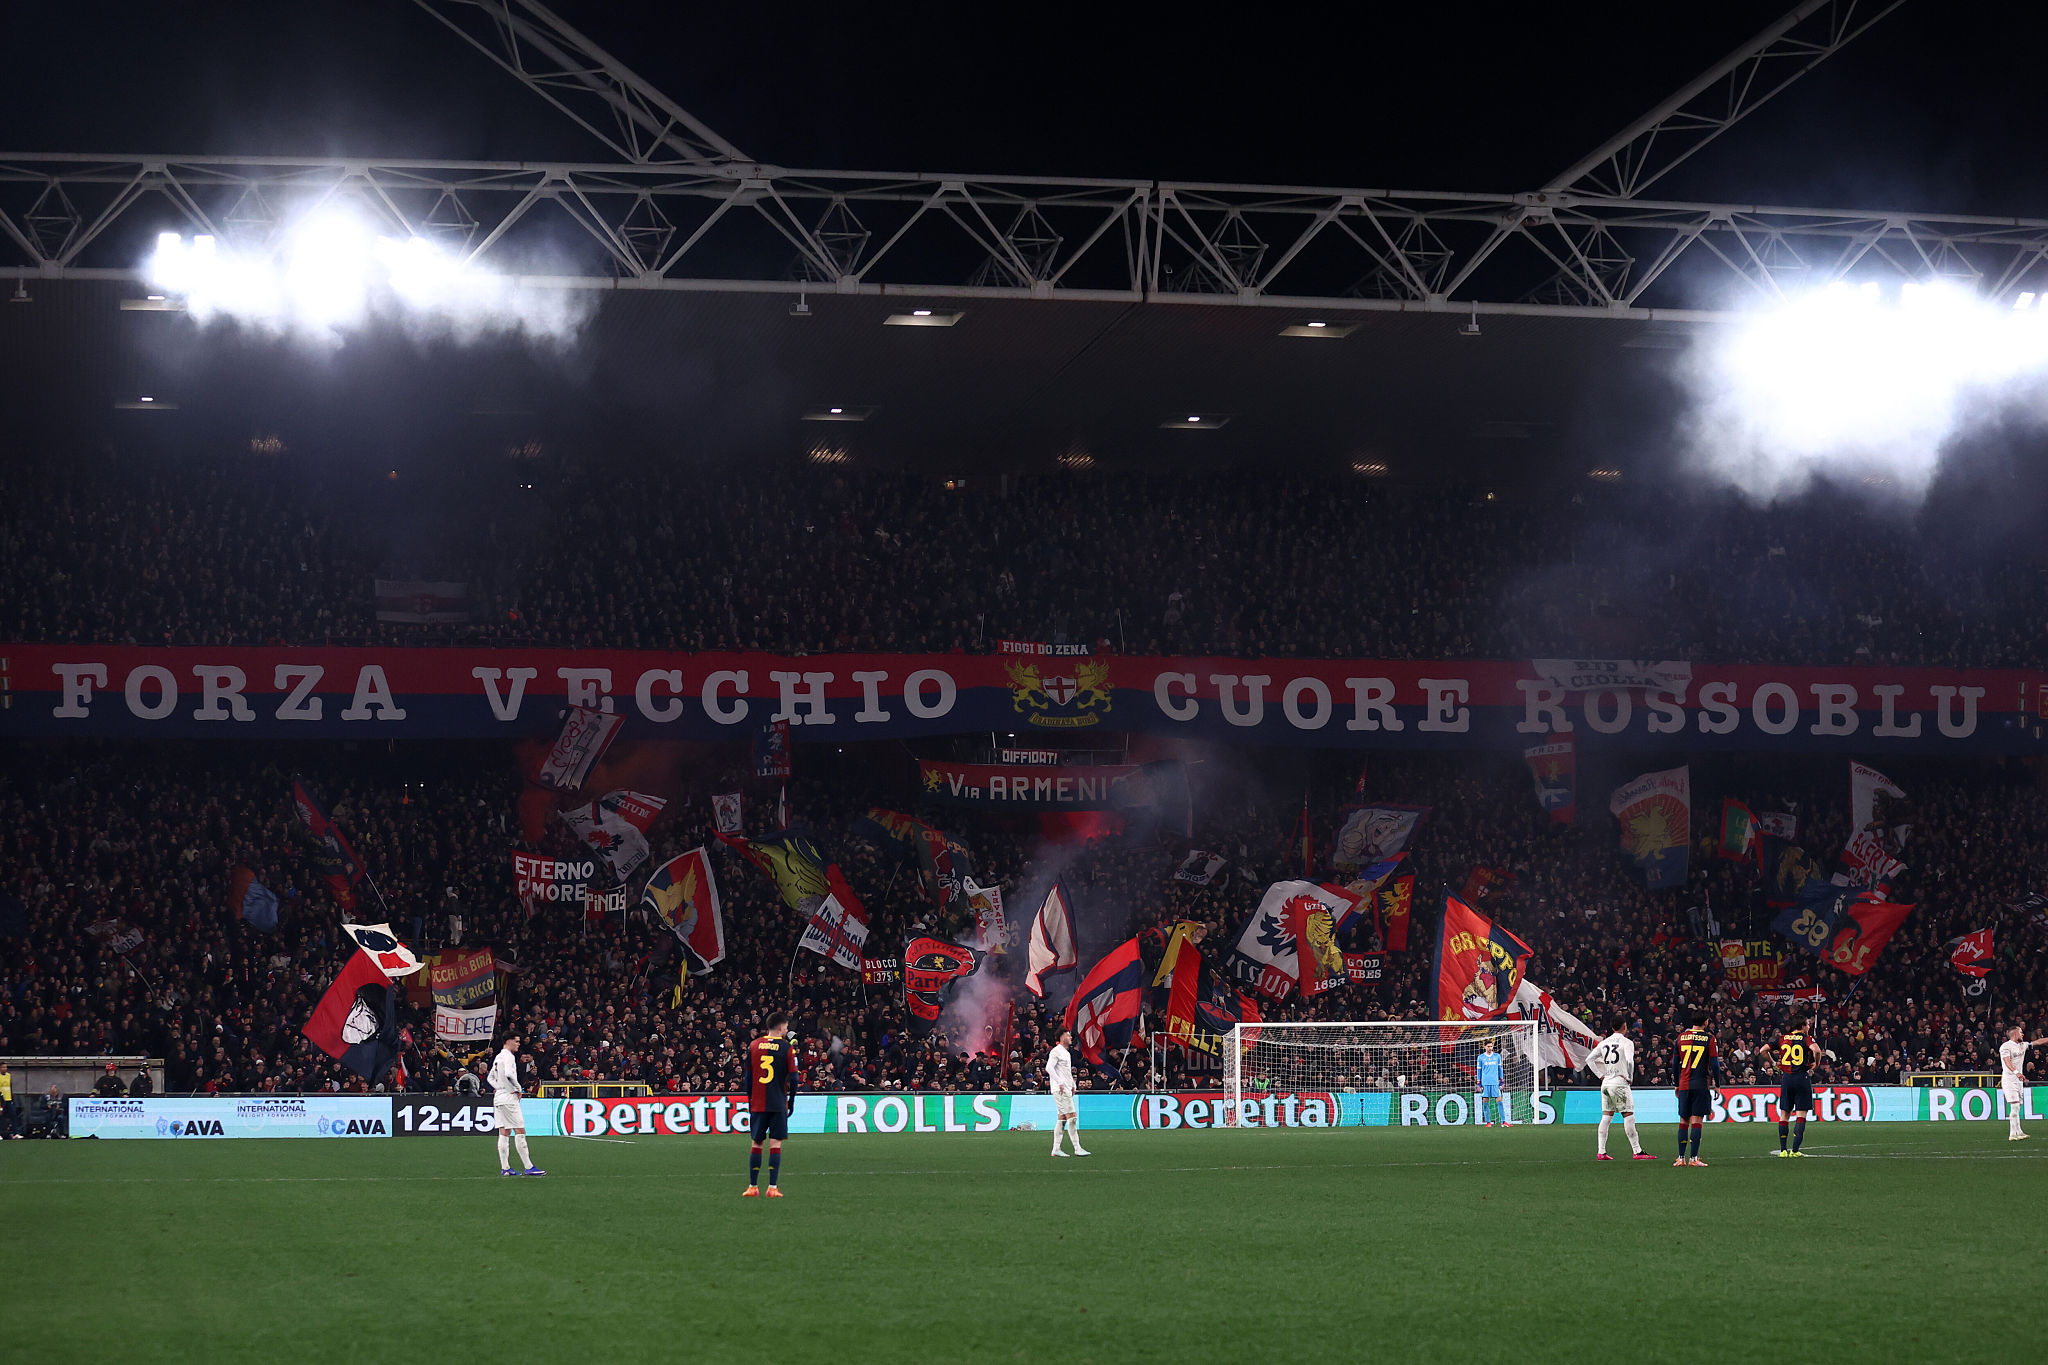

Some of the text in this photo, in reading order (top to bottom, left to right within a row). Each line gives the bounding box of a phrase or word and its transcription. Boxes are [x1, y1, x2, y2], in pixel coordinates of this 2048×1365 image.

[1003, 641, 1089, 656] FIGGI DO ZENA
[53, 663, 1985, 738] FORZA VECCHIO CUORE ROSSOBLU
[1003, 748, 1058, 765] DIFFIDATI
[515, 856, 595, 881] ETERNO
[469, 952, 493, 972] BIRA
[865, 958, 897, 969] BLOCCO
[1347, 957, 1380, 968] GOOD
[1348, 968, 1381, 979] VIBES
[876, 971, 892, 982] 375
[437, 1014, 494, 1035] GODERE
[1169, 1014, 1226, 1058] COLLE
[1602, 1044, 1619, 1065] 23
[1680, 1044, 1706, 1069] 77
[1781, 1043, 1804, 1066] 29
[759, 1055, 775, 1084] 3
[571, 1096, 750, 1135] Beretta
[836, 1094, 1003, 1133] ROLLS
[1145, 1093, 1331, 1129] Beretta
[1400, 1090, 1557, 1126] ROLLS
[1704, 1087, 1863, 1122] ertta
[170, 1119, 225, 1136] CAVA
[331, 1119, 387, 1135] CAVA
[397, 1104, 497, 1132] 12:45
